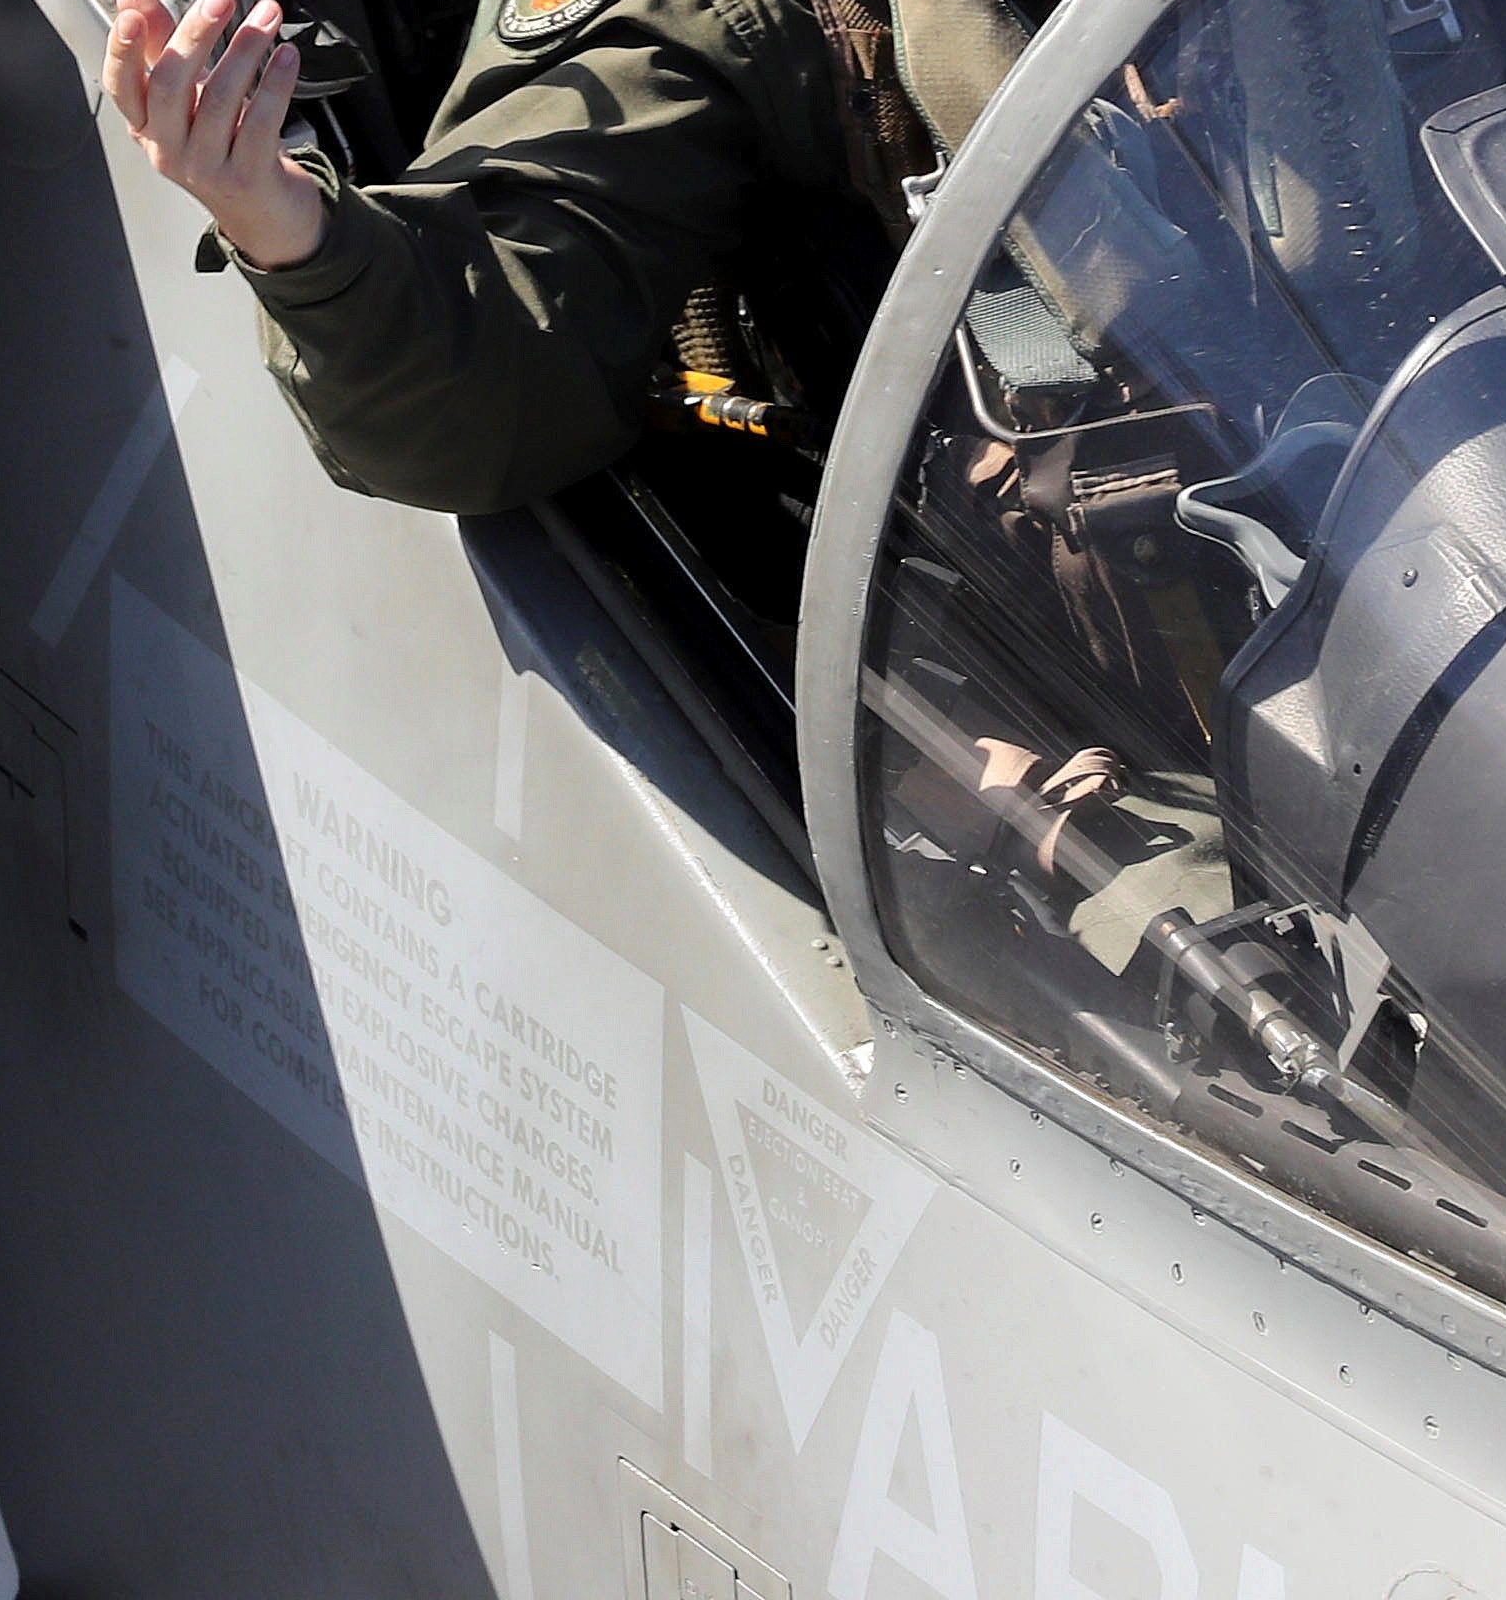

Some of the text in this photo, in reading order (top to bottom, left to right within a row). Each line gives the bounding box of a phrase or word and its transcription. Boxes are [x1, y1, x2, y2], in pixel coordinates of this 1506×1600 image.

[145, 718, 619, 1110] THIS AIRCRAFT CONTAINS A CARTRIDGE
[293, 772, 452, 927] WARNING
[149, 781, 614, 1163] ACTUATED EMERGENCY ESCAPE SYSTEM
[161, 838, 600, 1206] EQUIPPED WITH EXPLOSIVE CHARGES.
[144, 877, 624, 1277] SEE APPLICABLE MAINTENANCE MANUAL
[199, 974, 563, 1282] FOR COMPLETE INSTRUCTIONS.
[761, 1080, 849, 1162] DANGER
[727, 1154, 781, 1304] DANGER
[746, 1118, 861, 1212] EJECTION SEAT
[768, 1198, 837, 1253] CANOPY
[819, 1247, 879, 1351] DANGER
